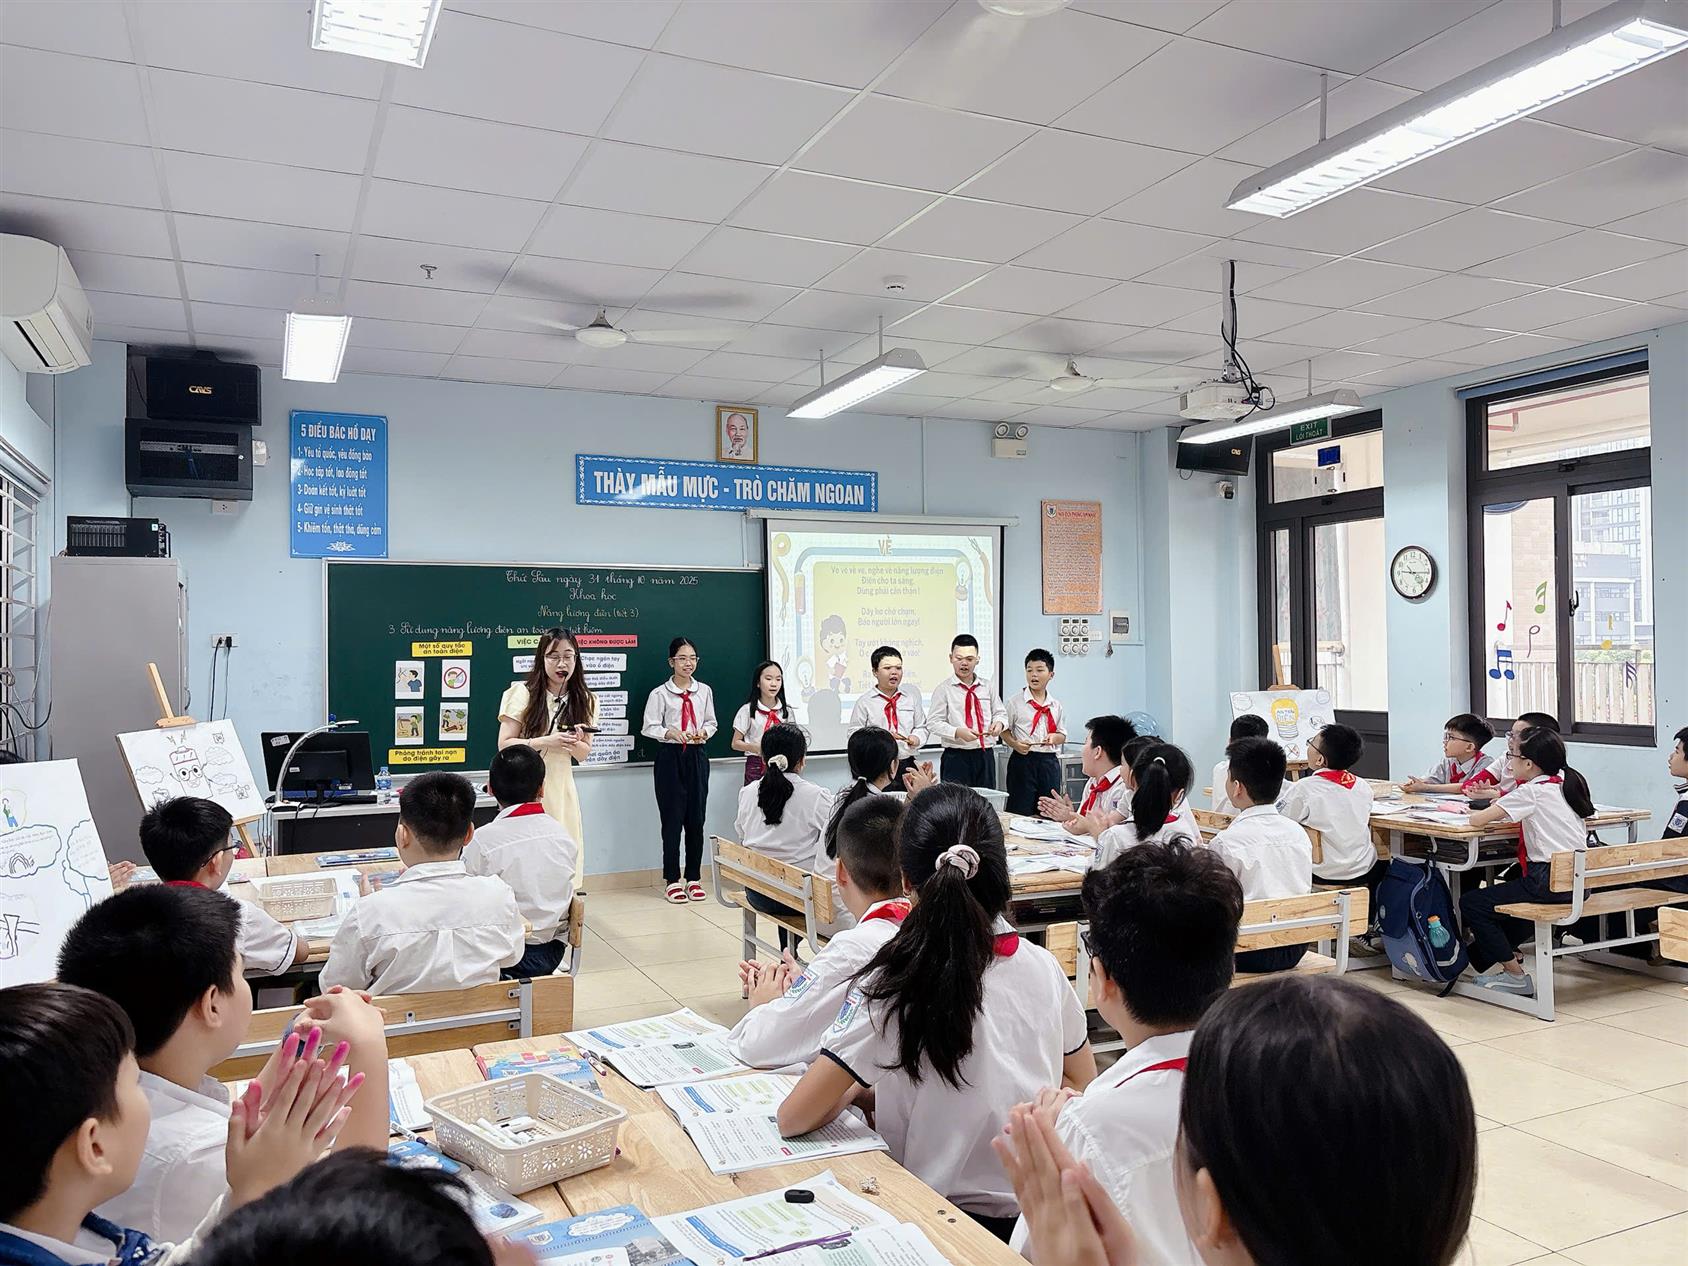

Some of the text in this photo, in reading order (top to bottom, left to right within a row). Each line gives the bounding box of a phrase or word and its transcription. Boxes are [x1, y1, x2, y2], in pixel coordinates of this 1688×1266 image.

[1300, 421, 1317, 431] EXIT
[301, 424, 307, 437] 5
[329, 423, 346, 440] BÁC
[360, 427, 376, 444] DẠY
[594, 467, 636, 495] THÀY
[641, 466, 678, 497] MẪU
[683, 474, 719, 502] MỰC
[733, 474, 762, 501] TRÒ
[767, 477, 811, 503] CHĂM
[814, 483, 864, 505] NGOAN
[331, 504, 342, 516] sinh
[556, 574, 582, 588] ngày
[588, 573, 600, 584] 31
[606, 572, 634, 588] tháng
[637, 575, 645, 584] 10
[651, 576, 675, 585] năm
[679, 576, 699, 585] 2025
[569, 587, 596, 600] Khoa
[630, 607, 639, 618] 3)
[516, 636, 532, 646] VIỆC
